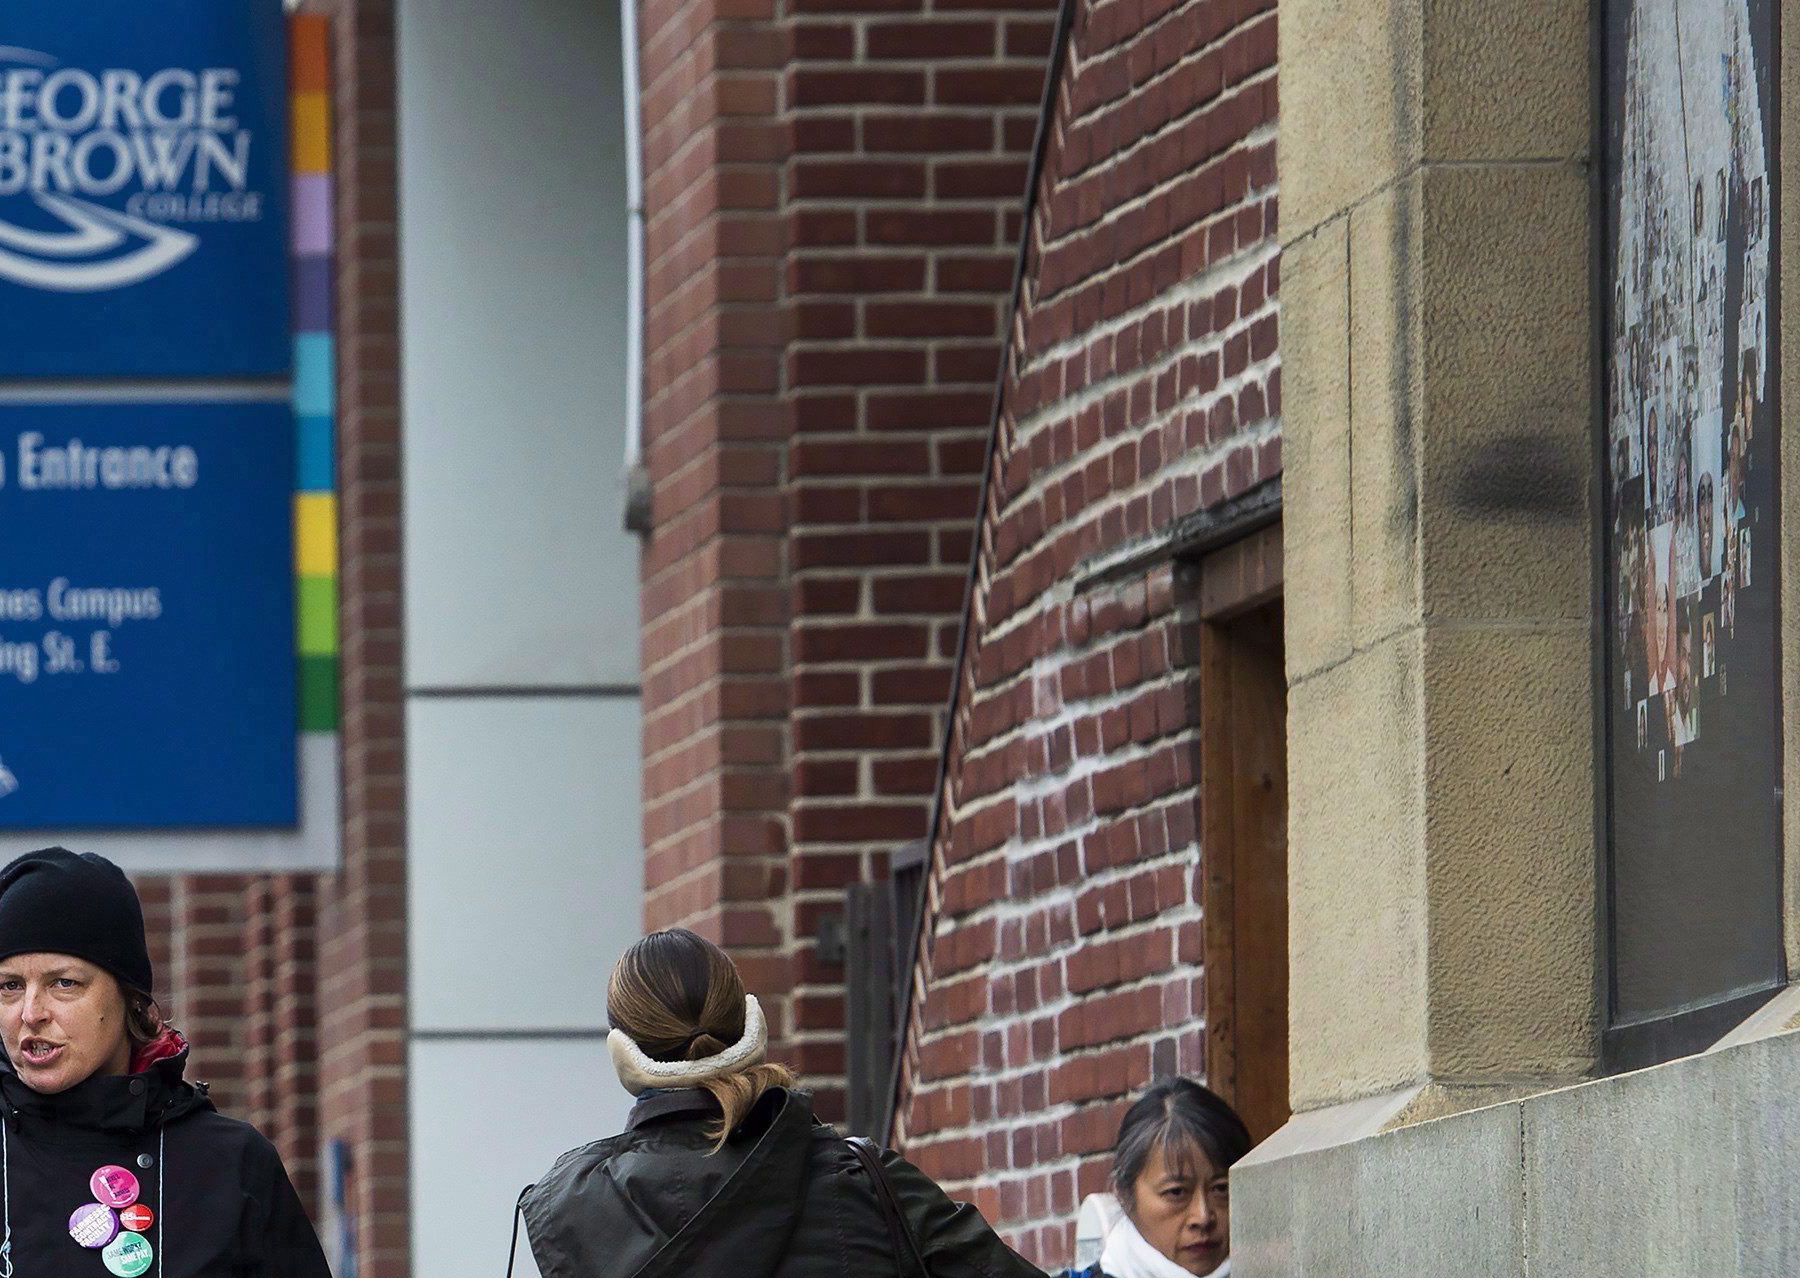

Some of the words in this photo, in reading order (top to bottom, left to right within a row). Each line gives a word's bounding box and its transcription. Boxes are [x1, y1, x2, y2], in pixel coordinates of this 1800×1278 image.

[125, 191, 262, 222] COLLEGE
[17, 431, 198, 490] Entrance
[47, 576, 163, 628] Campus
[42, 630, 84, 674] St.
[90, 630, 121, 674] E.
